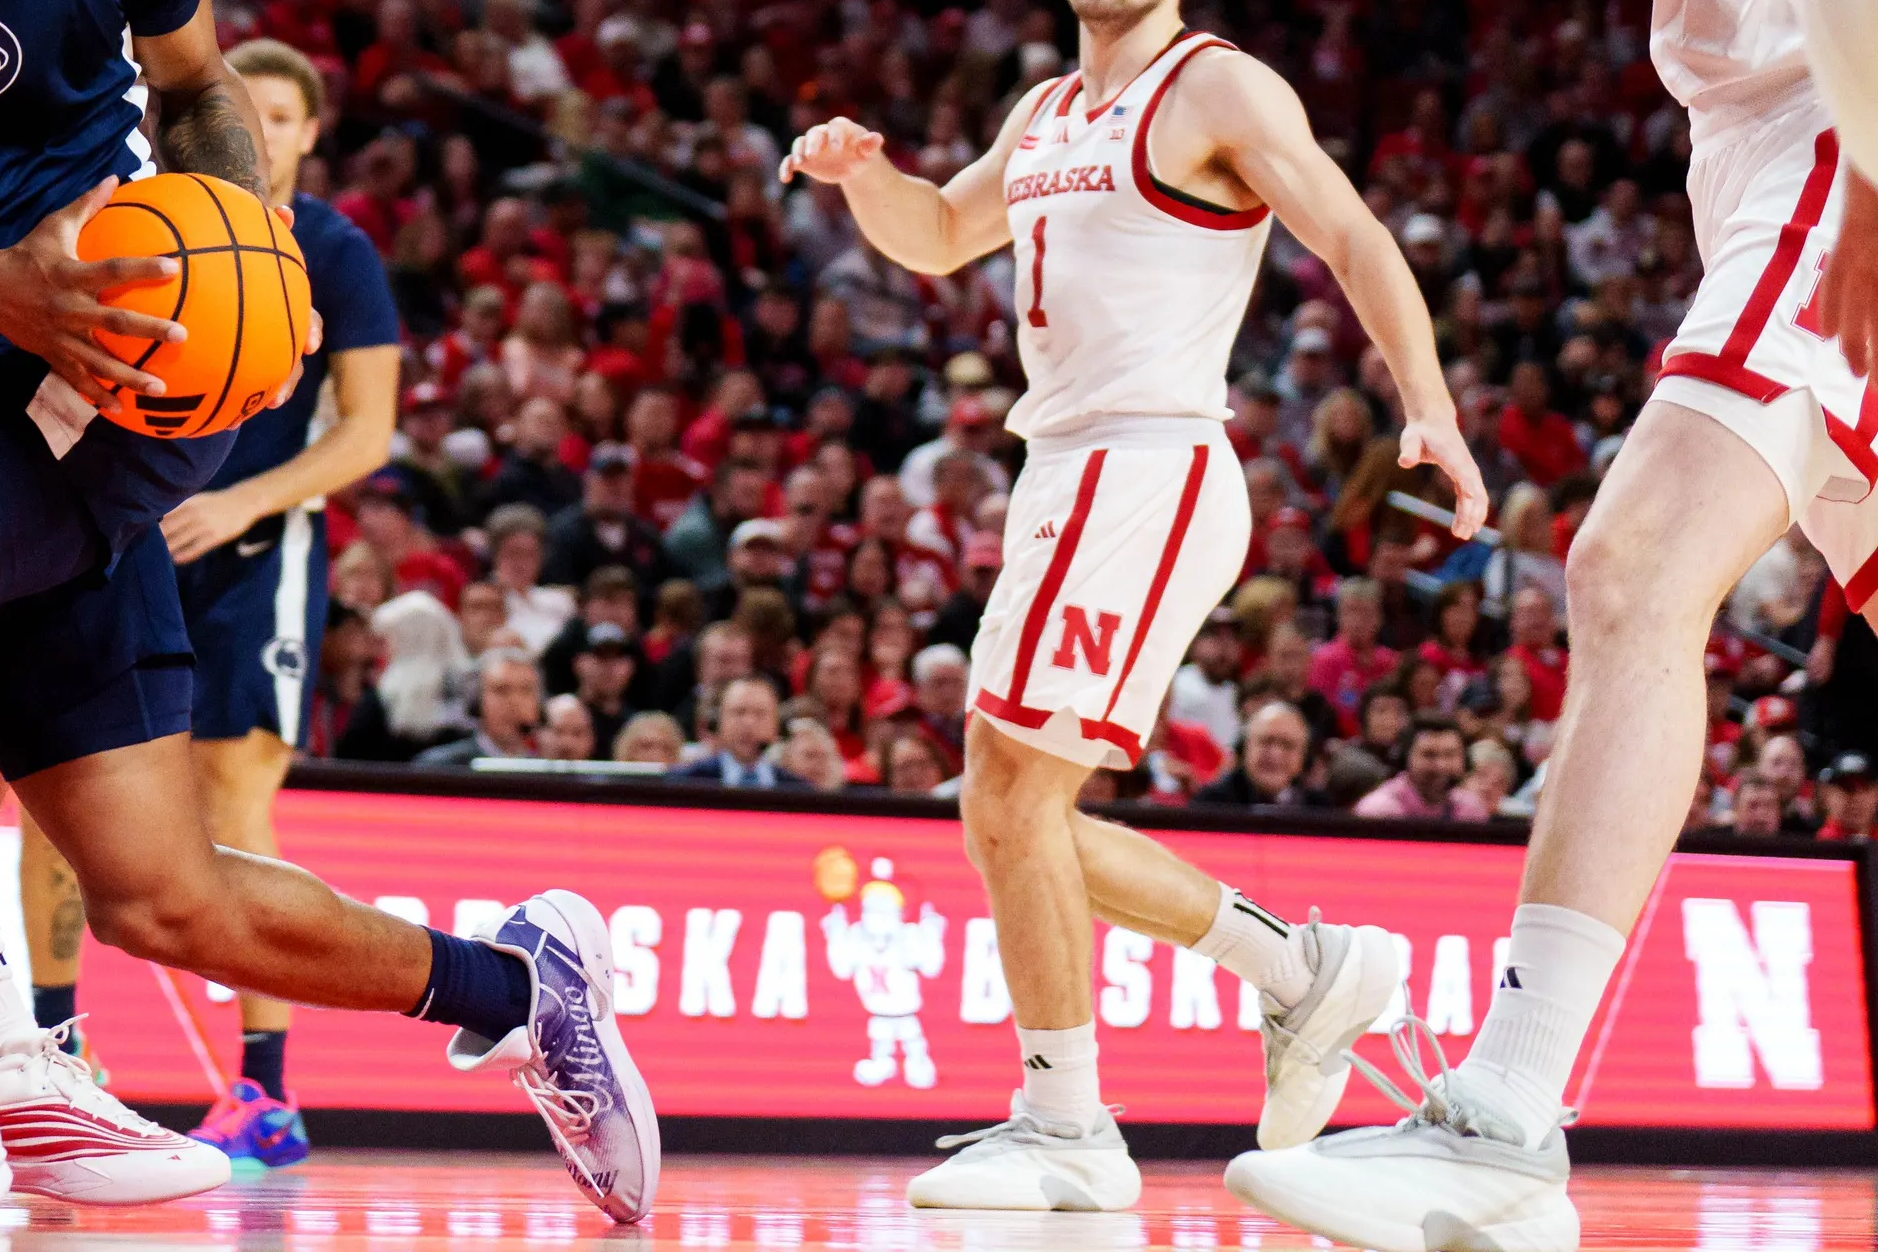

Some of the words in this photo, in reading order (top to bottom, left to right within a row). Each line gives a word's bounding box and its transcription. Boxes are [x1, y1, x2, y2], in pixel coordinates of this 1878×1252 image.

[1006, 164, 1116, 206] NEBRASKA
[1027, 215, 1049, 328] 1
[1050, 602, 1124, 677] N
[1681, 897, 1824, 1090] N
